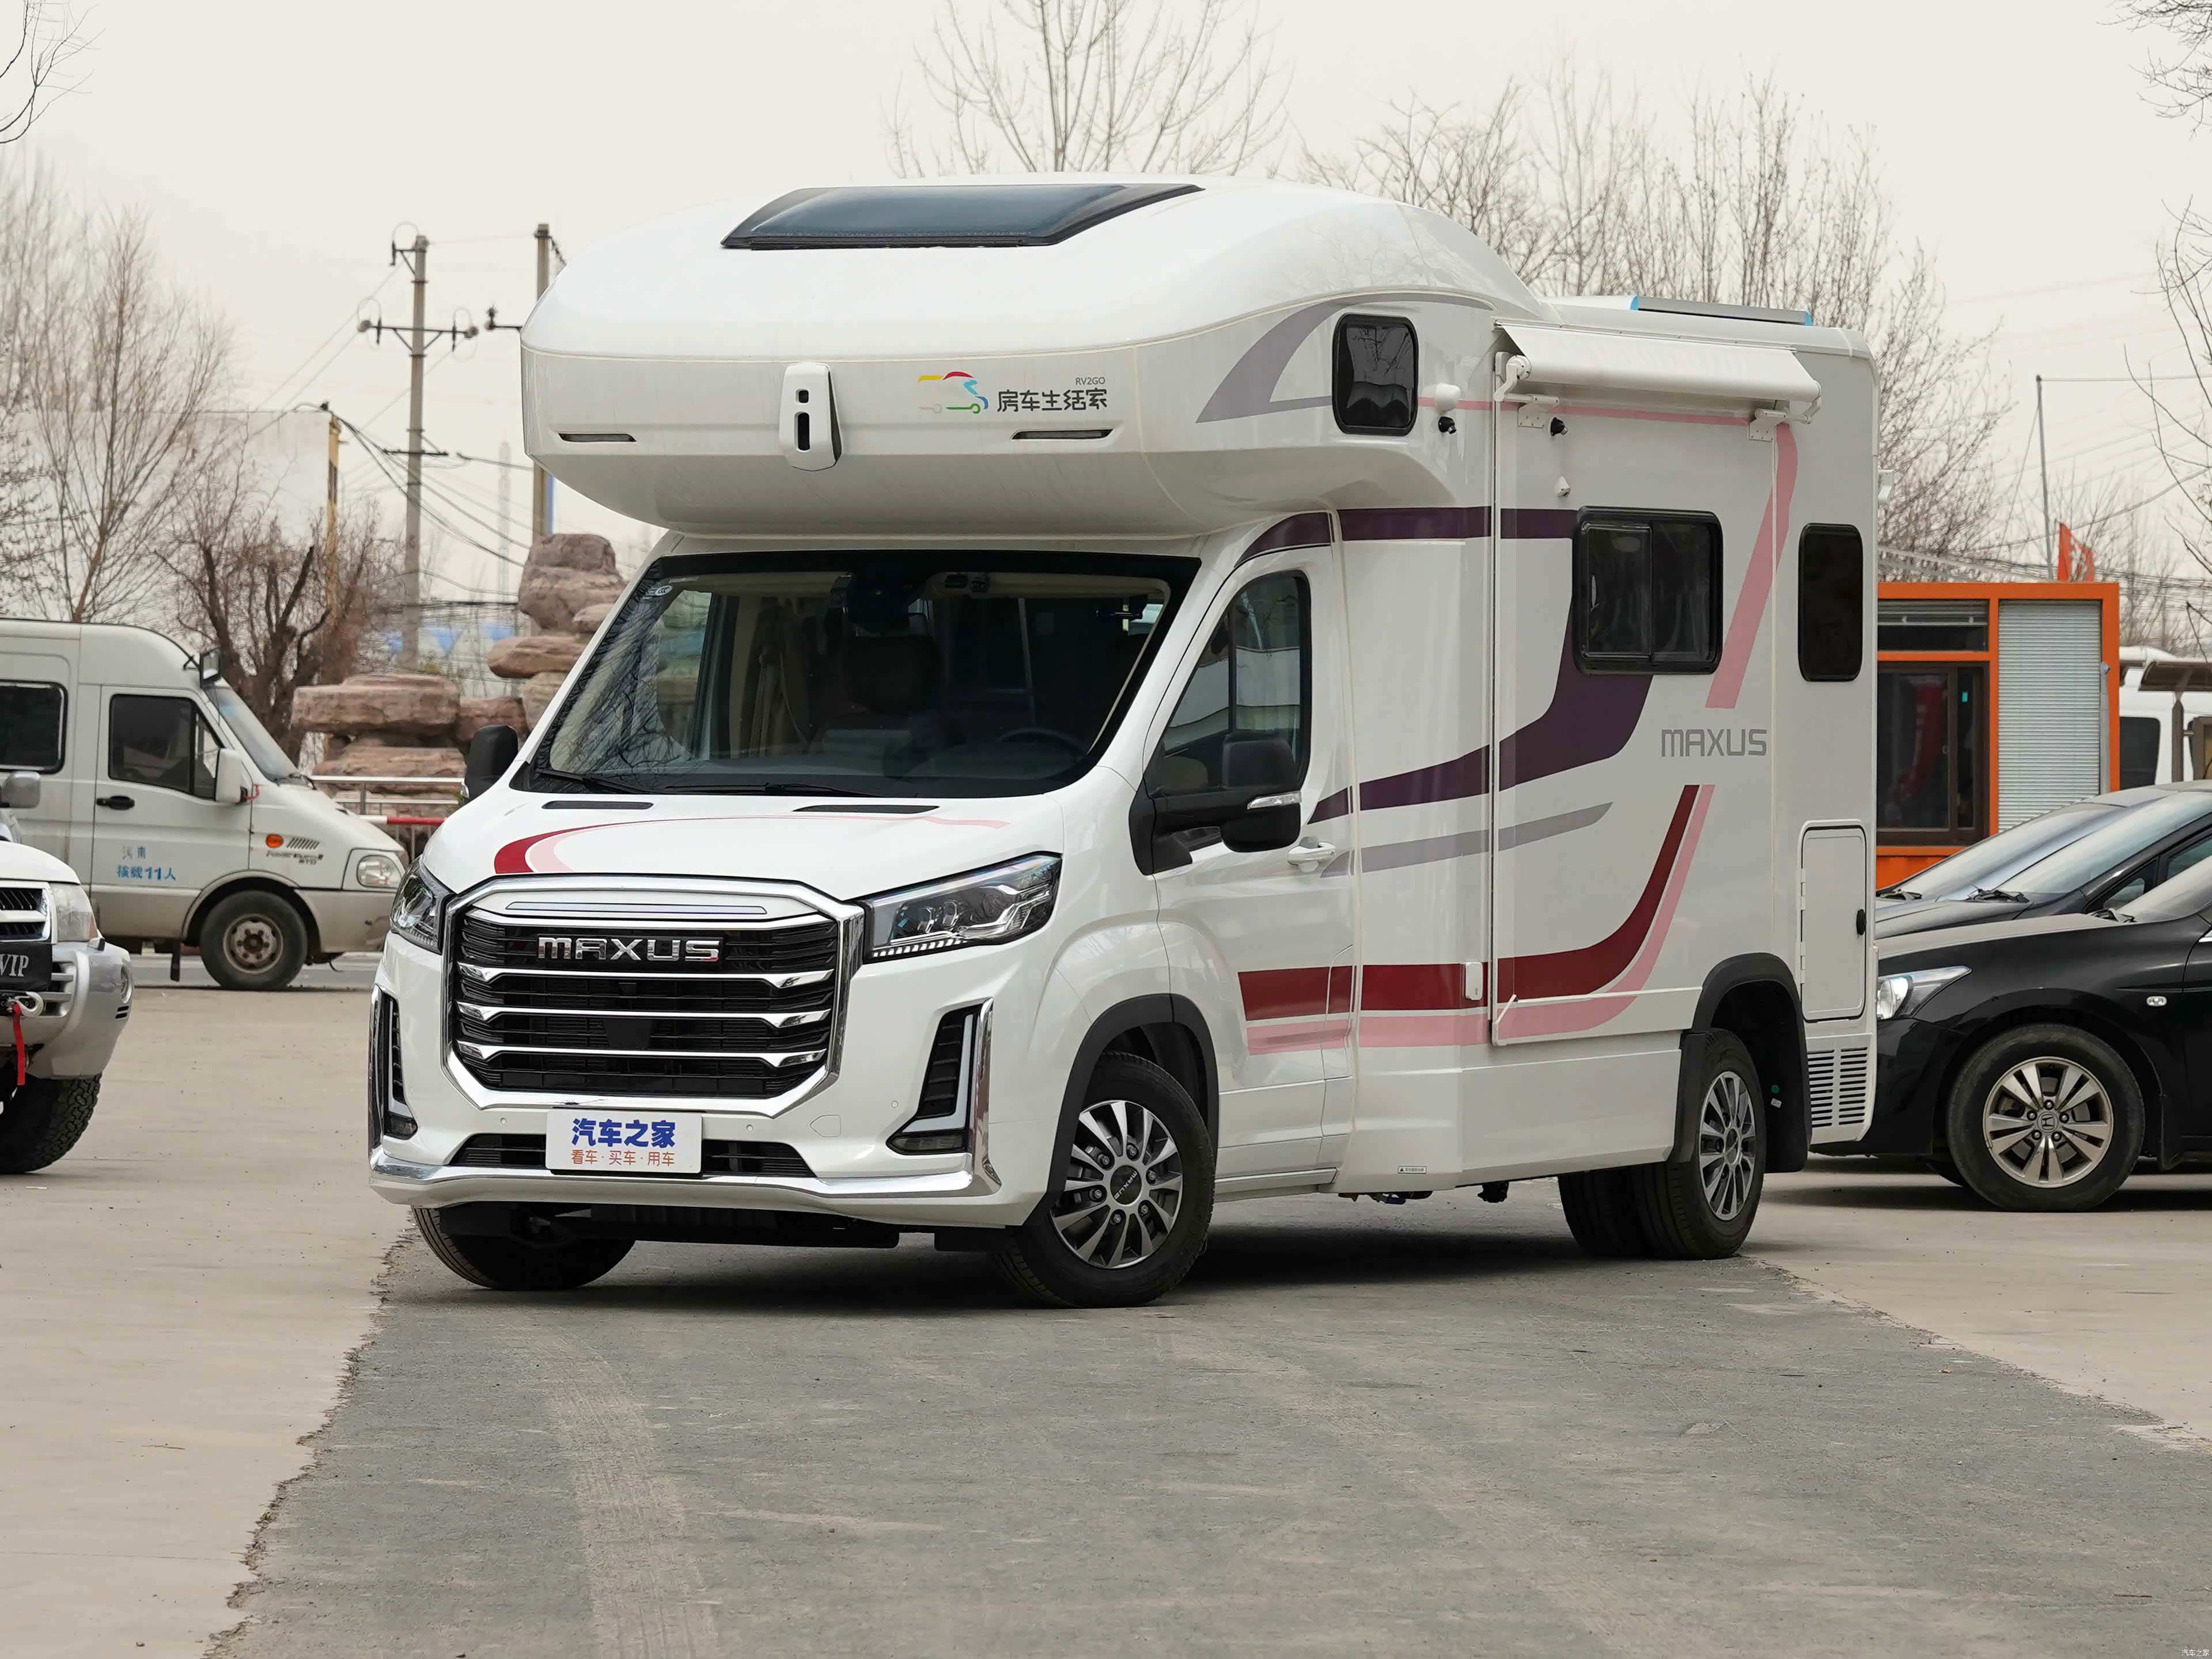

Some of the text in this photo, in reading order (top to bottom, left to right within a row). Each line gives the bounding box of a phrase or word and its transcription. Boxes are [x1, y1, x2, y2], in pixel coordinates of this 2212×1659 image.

[1075, 377, 1105, 385] RV2GO
[1661, 729, 1767, 757] MAXUS
[537, 937, 720, 961] MAXUS
[571, 1118, 676, 1148] 汽车之家
